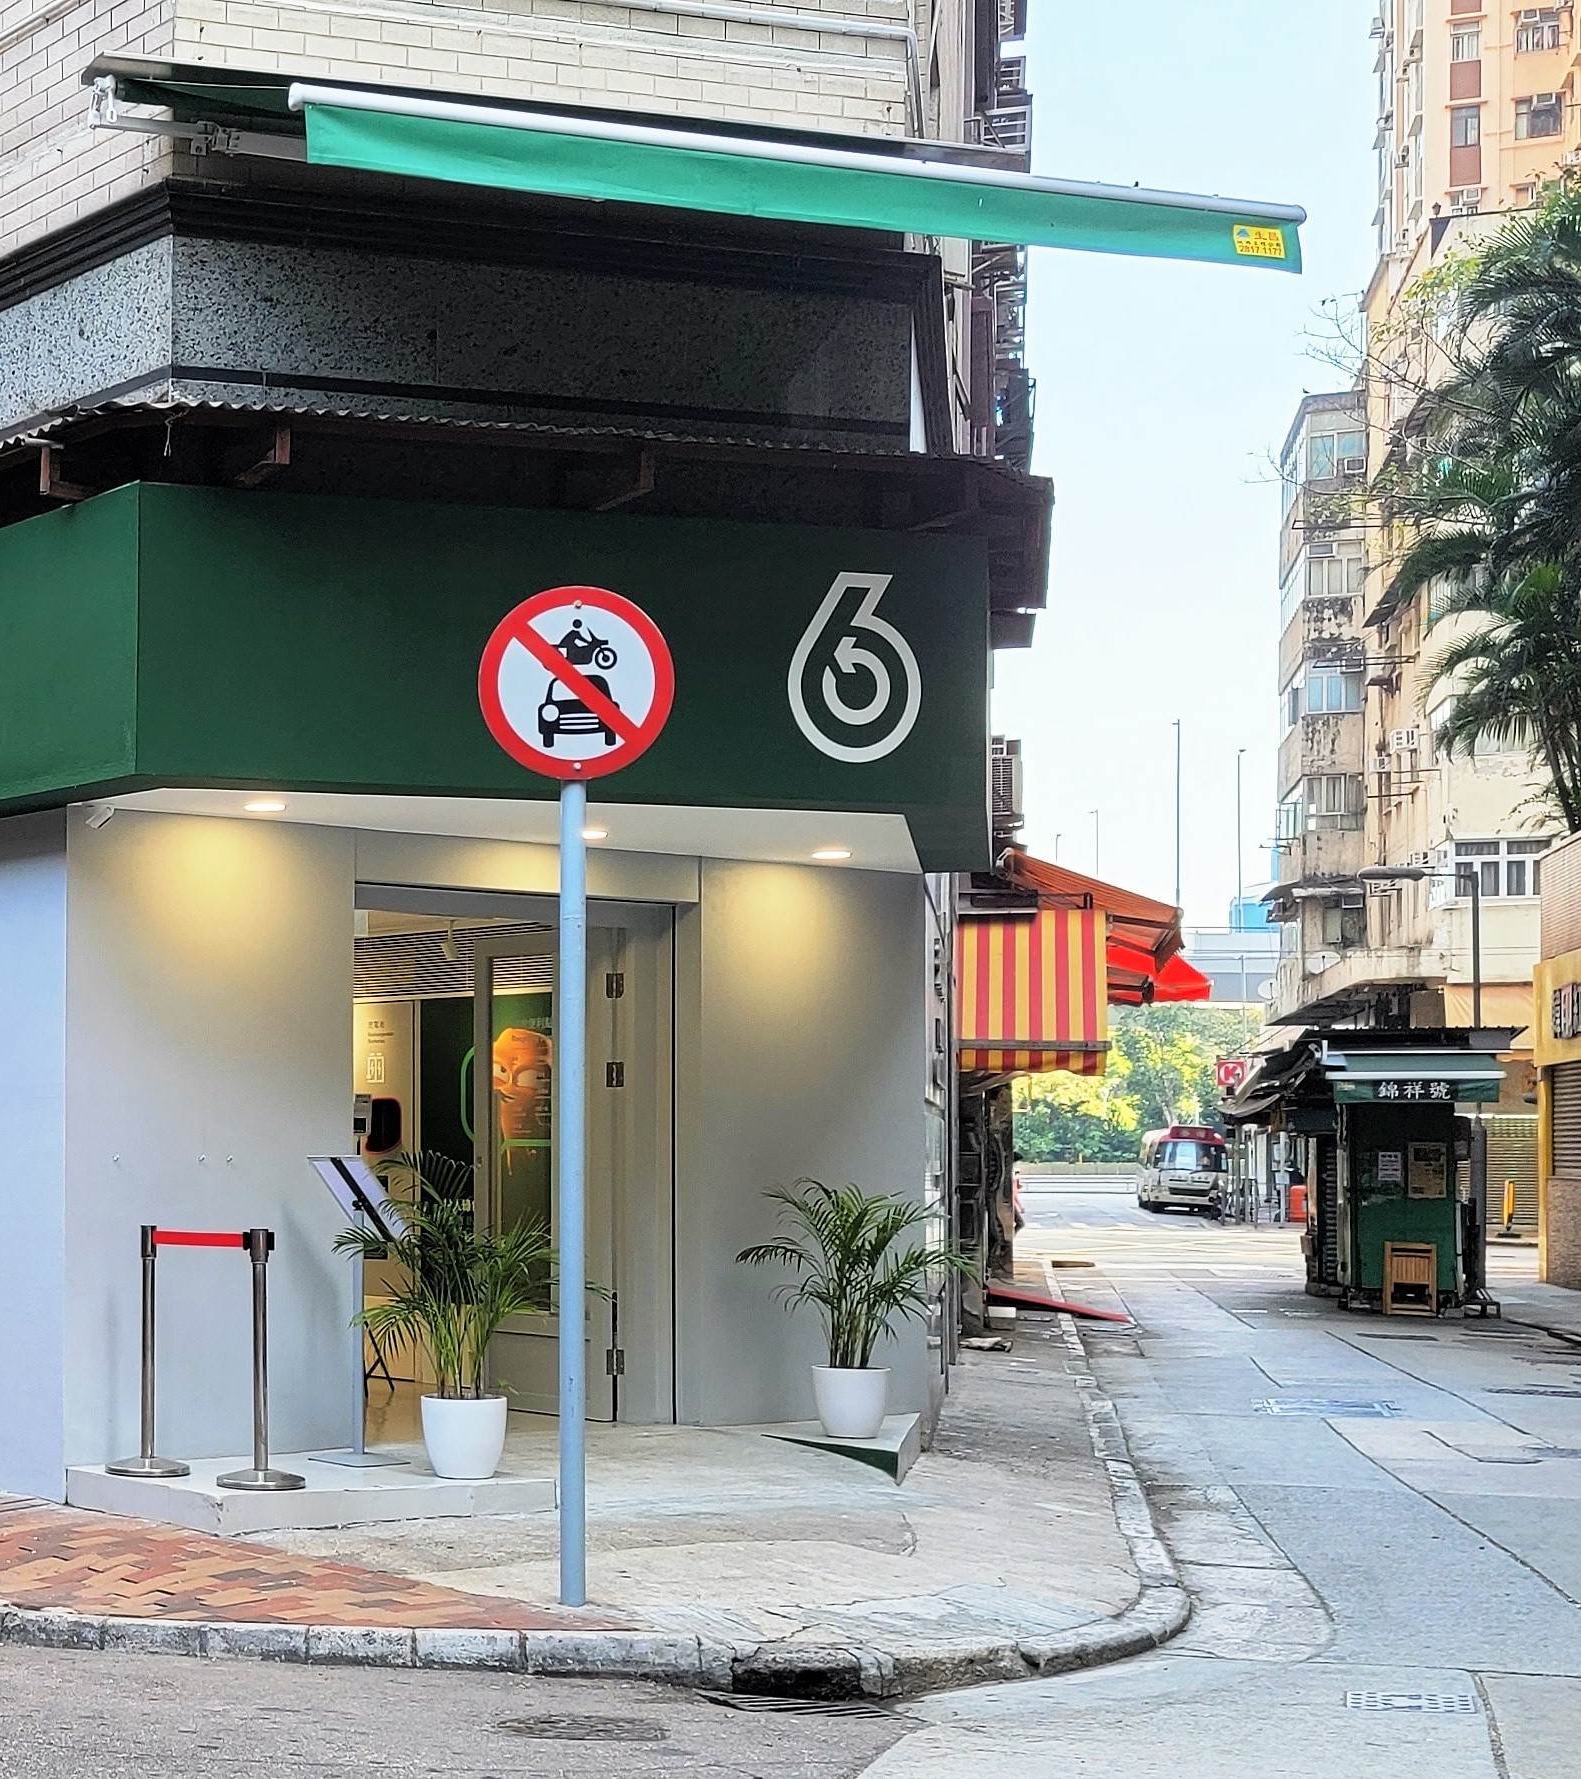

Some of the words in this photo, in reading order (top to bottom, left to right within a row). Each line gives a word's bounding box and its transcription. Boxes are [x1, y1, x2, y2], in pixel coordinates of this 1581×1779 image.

[788, 572, 922, 763] 6
[1377, 1081, 1452, 1101] 錦祥號
